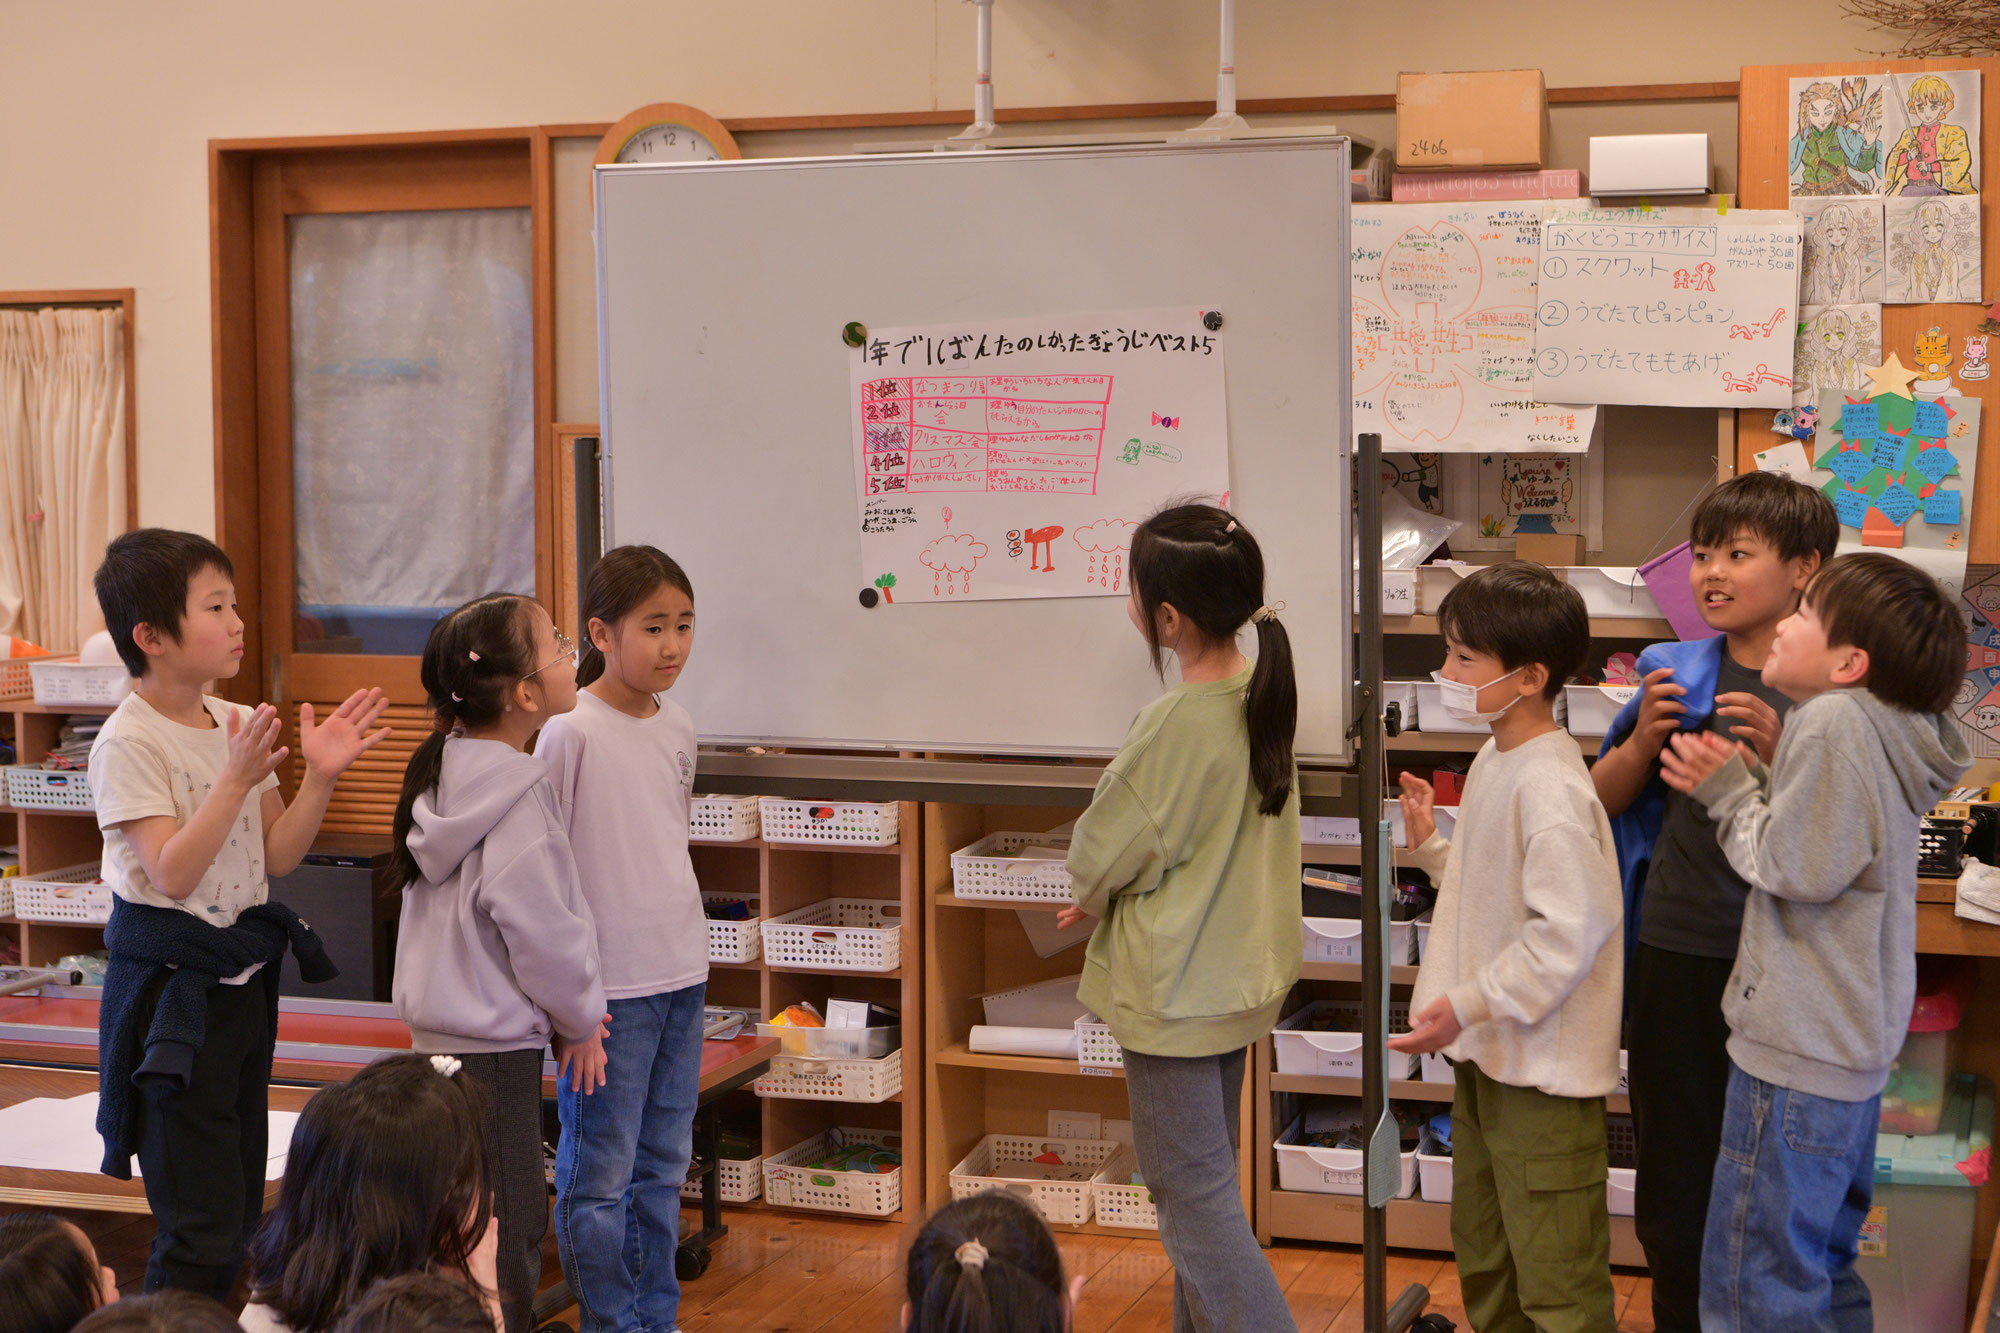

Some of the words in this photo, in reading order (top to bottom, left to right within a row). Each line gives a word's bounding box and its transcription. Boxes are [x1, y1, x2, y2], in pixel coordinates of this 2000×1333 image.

[642, 141, 653, 153] 11
[663, 132, 677, 146] 12
[691, 140, 697, 152] 1
[1412, 138, 1448, 157] 2406
[1553, 226, 1716, 250] がくどうエクササイズ
[1727, 234, 1765, 244] しょしんしゃ
[1769, 233, 1794, 244] 20回
[1769, 245, 1794, 258] 30回
[1576, 257, 1669, 279] スクワット
[1727, 260, 1763, 270] アスリート
[1767, 258, 1795, 271] 50回
[1575, 300, 1735, 325] うでたてピョンピョン
[1574, 347, 1732, 375] うでたてももあげ
[870, 380, 898, 401] 1位
[915, 378, 977, 394] なつまつり
[866, 402, 901, 421] 2位
[935, 409, 950, 425] 会
[914, 429, 985, 449] クリスマス会
[1527, 433, 1581, 444] なくしたいこと
[870, 452, 906, 472] 4位
[912, 452, 979, 470] ハロウィン
[1513, 461, 1553, 481] You're
[1527, 474, 1561, 484] ゆーあー
[870, 475, 906, 494] 5位
[1513, 483, 1560, 499] Welcome
[1989, 668, 2000, 681] 申
